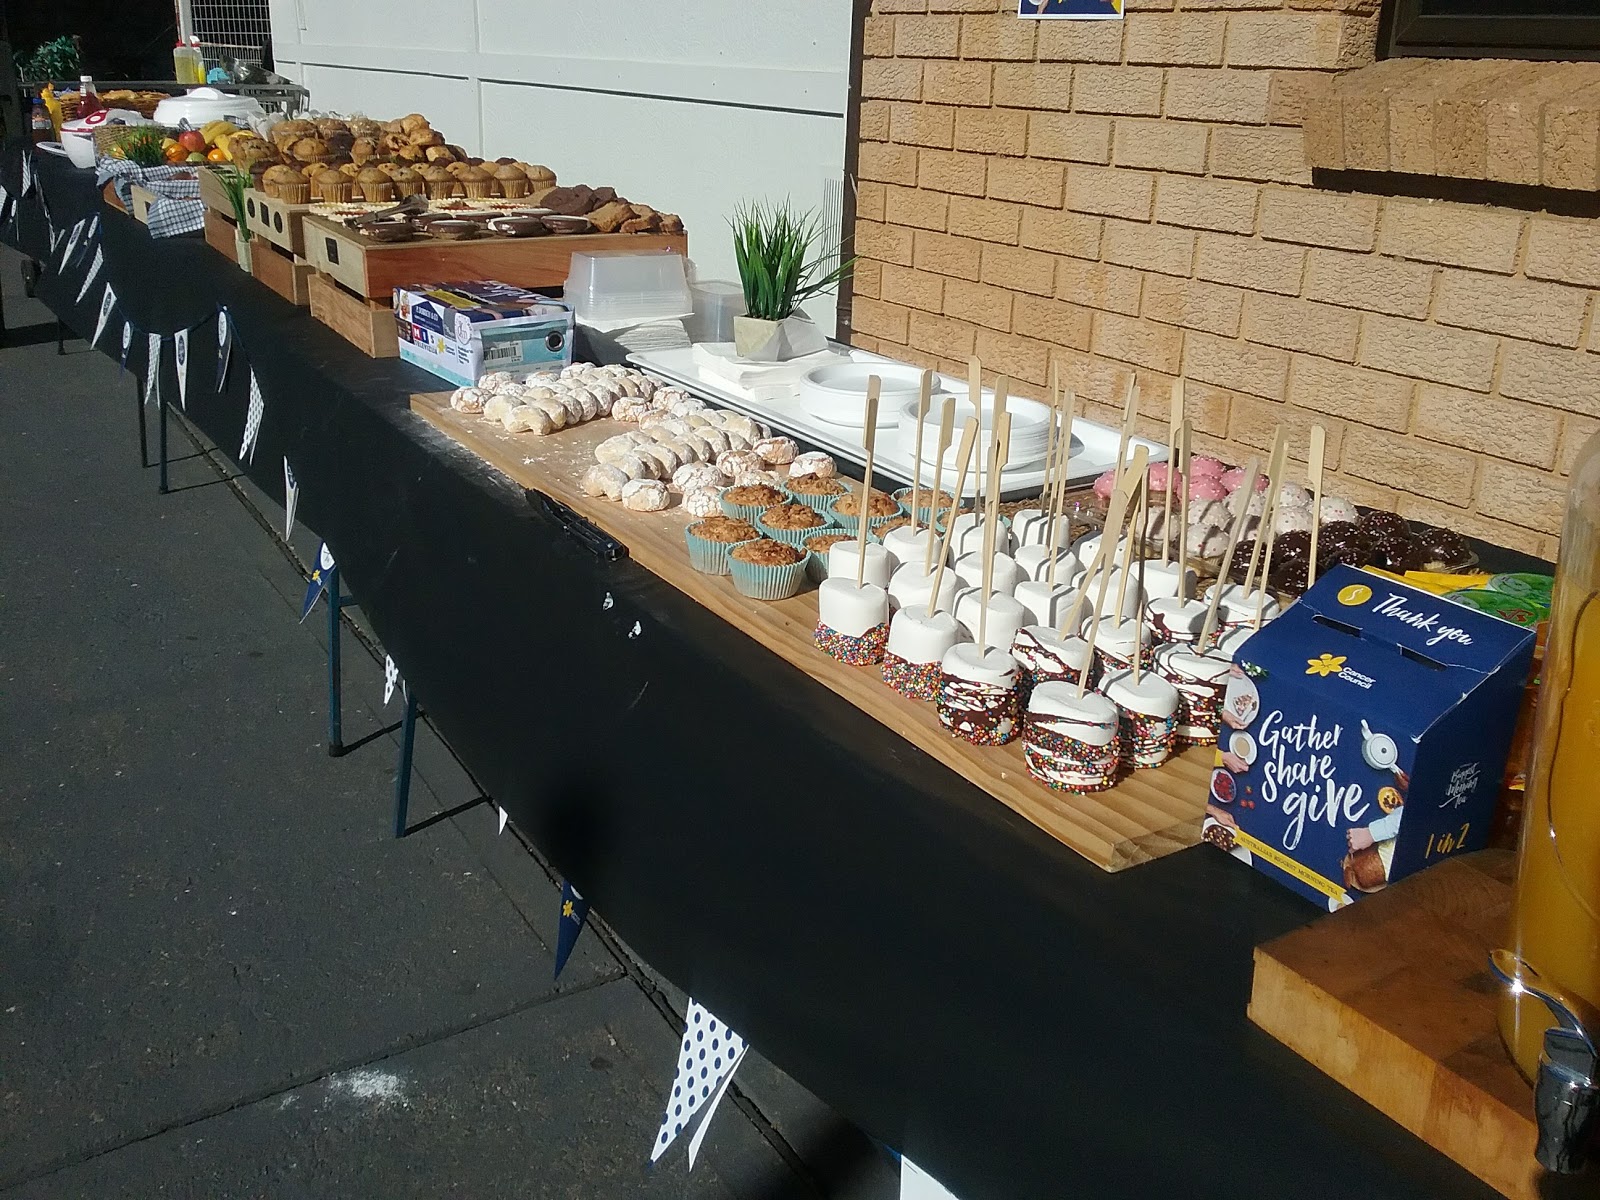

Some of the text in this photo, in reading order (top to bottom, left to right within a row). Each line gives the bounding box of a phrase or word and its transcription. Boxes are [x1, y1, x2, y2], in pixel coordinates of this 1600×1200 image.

[1372, 592, 1474, 646] Thank you
[1338, 671, 1372, 689] Council
[1343, 667, 1376, 683] Cancer
[1259, 710, 1343, 759] Gather
[1262, 744, 1336, 803] share
[1282, 778, 1370, 851] give
[1424, 822, 1470, 859] 1 in 2
[1327, 885, 1338, 896] TEA
